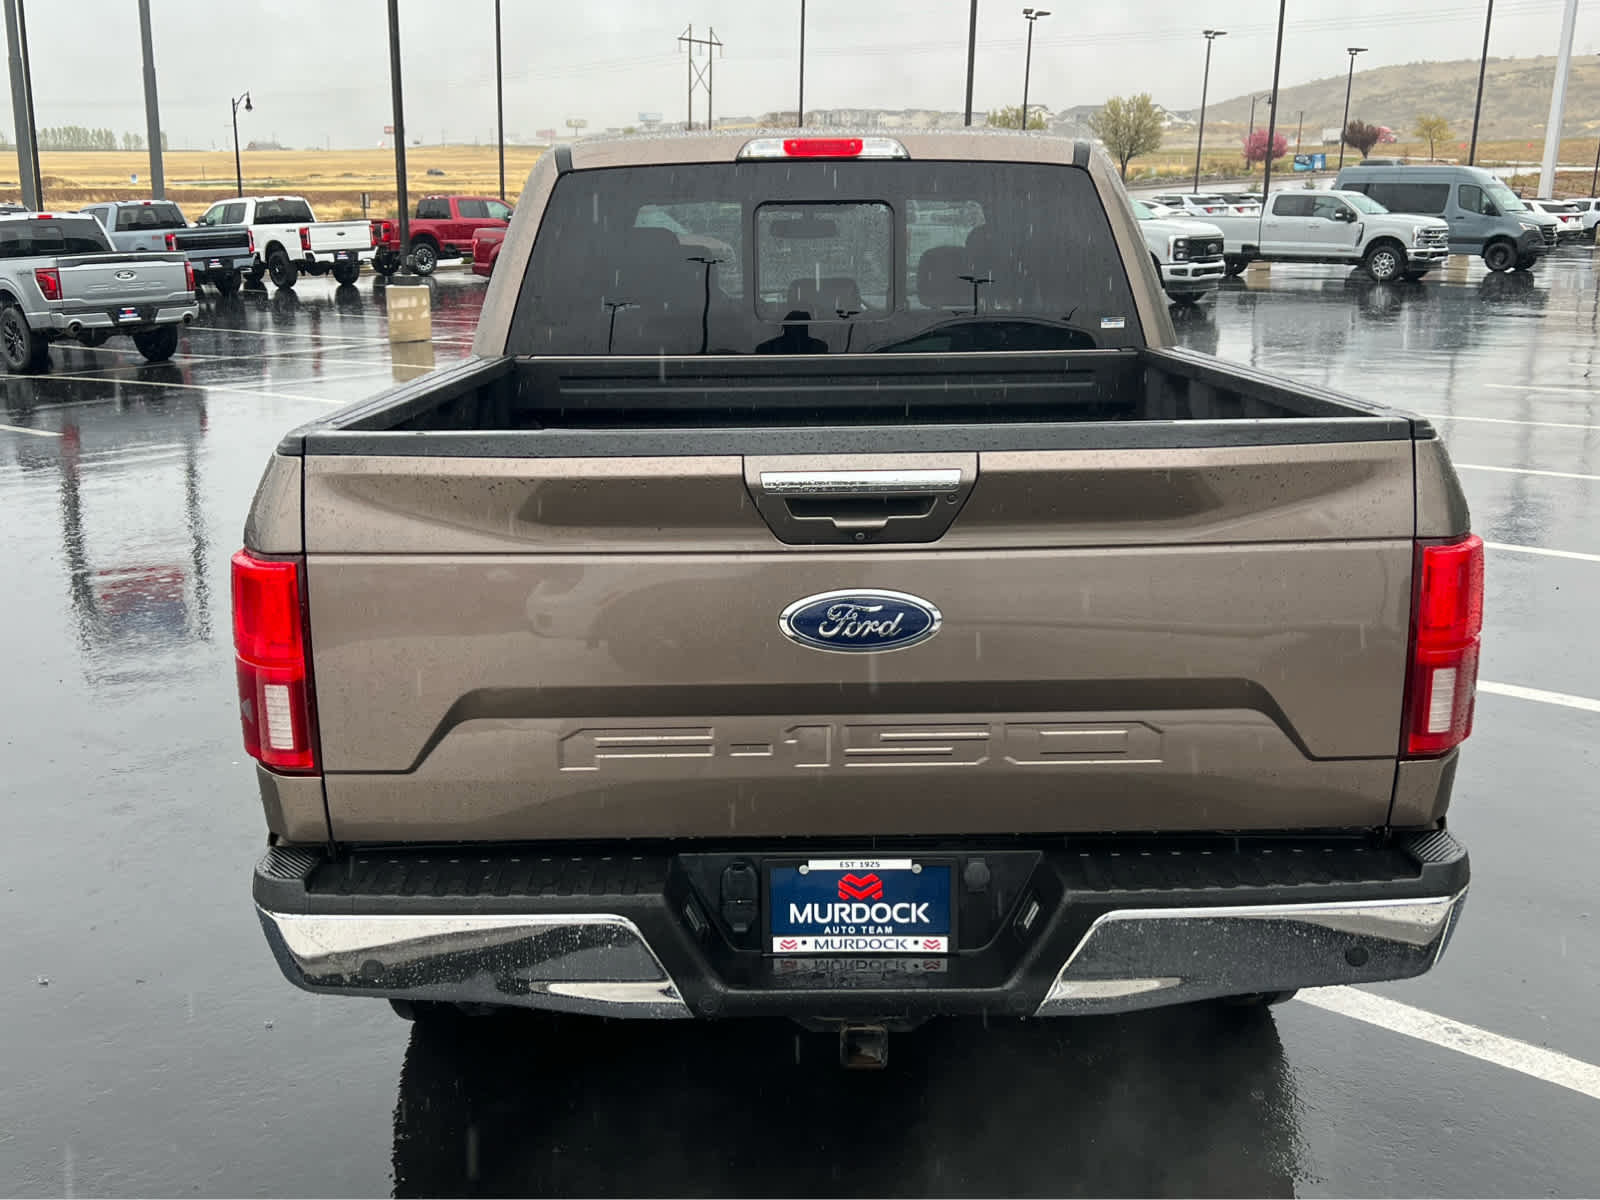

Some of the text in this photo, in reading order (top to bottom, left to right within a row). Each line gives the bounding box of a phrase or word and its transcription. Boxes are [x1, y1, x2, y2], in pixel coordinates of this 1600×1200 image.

[818, 603, 905, 638] Ford
[558, 721, 1165, 771] F-150
[789, 902, 930, 924] MURDOCK
[823, 925, 893, 934] AUTO TEAM
[813, 938, 909, 950] MURDOCK
